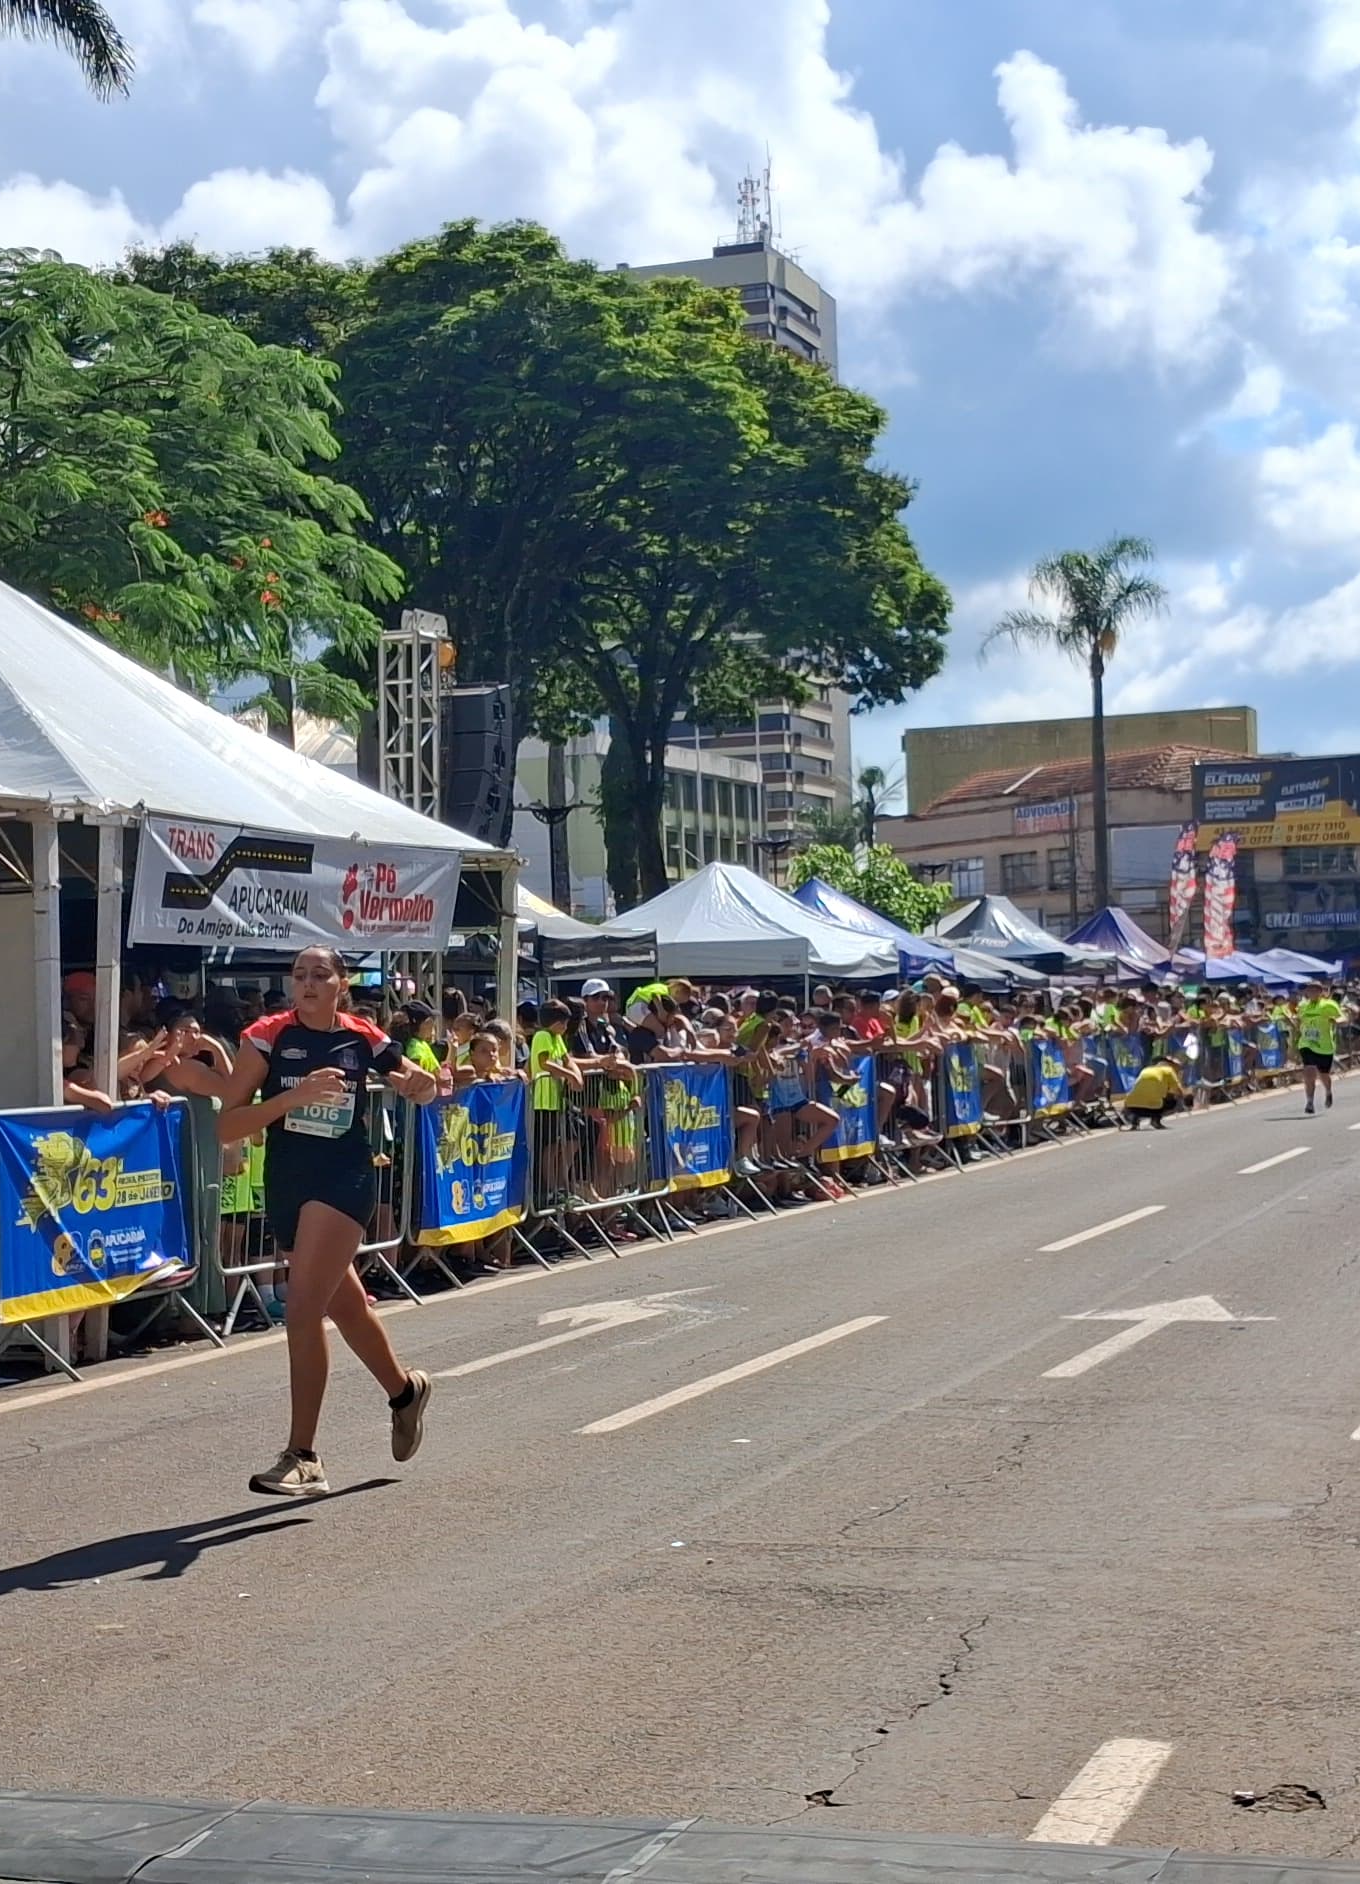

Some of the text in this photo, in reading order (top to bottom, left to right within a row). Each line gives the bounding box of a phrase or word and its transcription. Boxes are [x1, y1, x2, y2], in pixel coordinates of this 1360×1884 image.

[1205, 773, 1260, 786] ELETRAN
[168, 828, 216, 861] TRANS
[376, 862, 397, 893] Pé
[228, 884, 309, 919] APUCARANA
[360, 887, 435, 923] Vermelho
[177, 917, 194, 935] Do
[198, 918, 233, 940] Amigo
[302, 1104, 340, 1121] 1016
